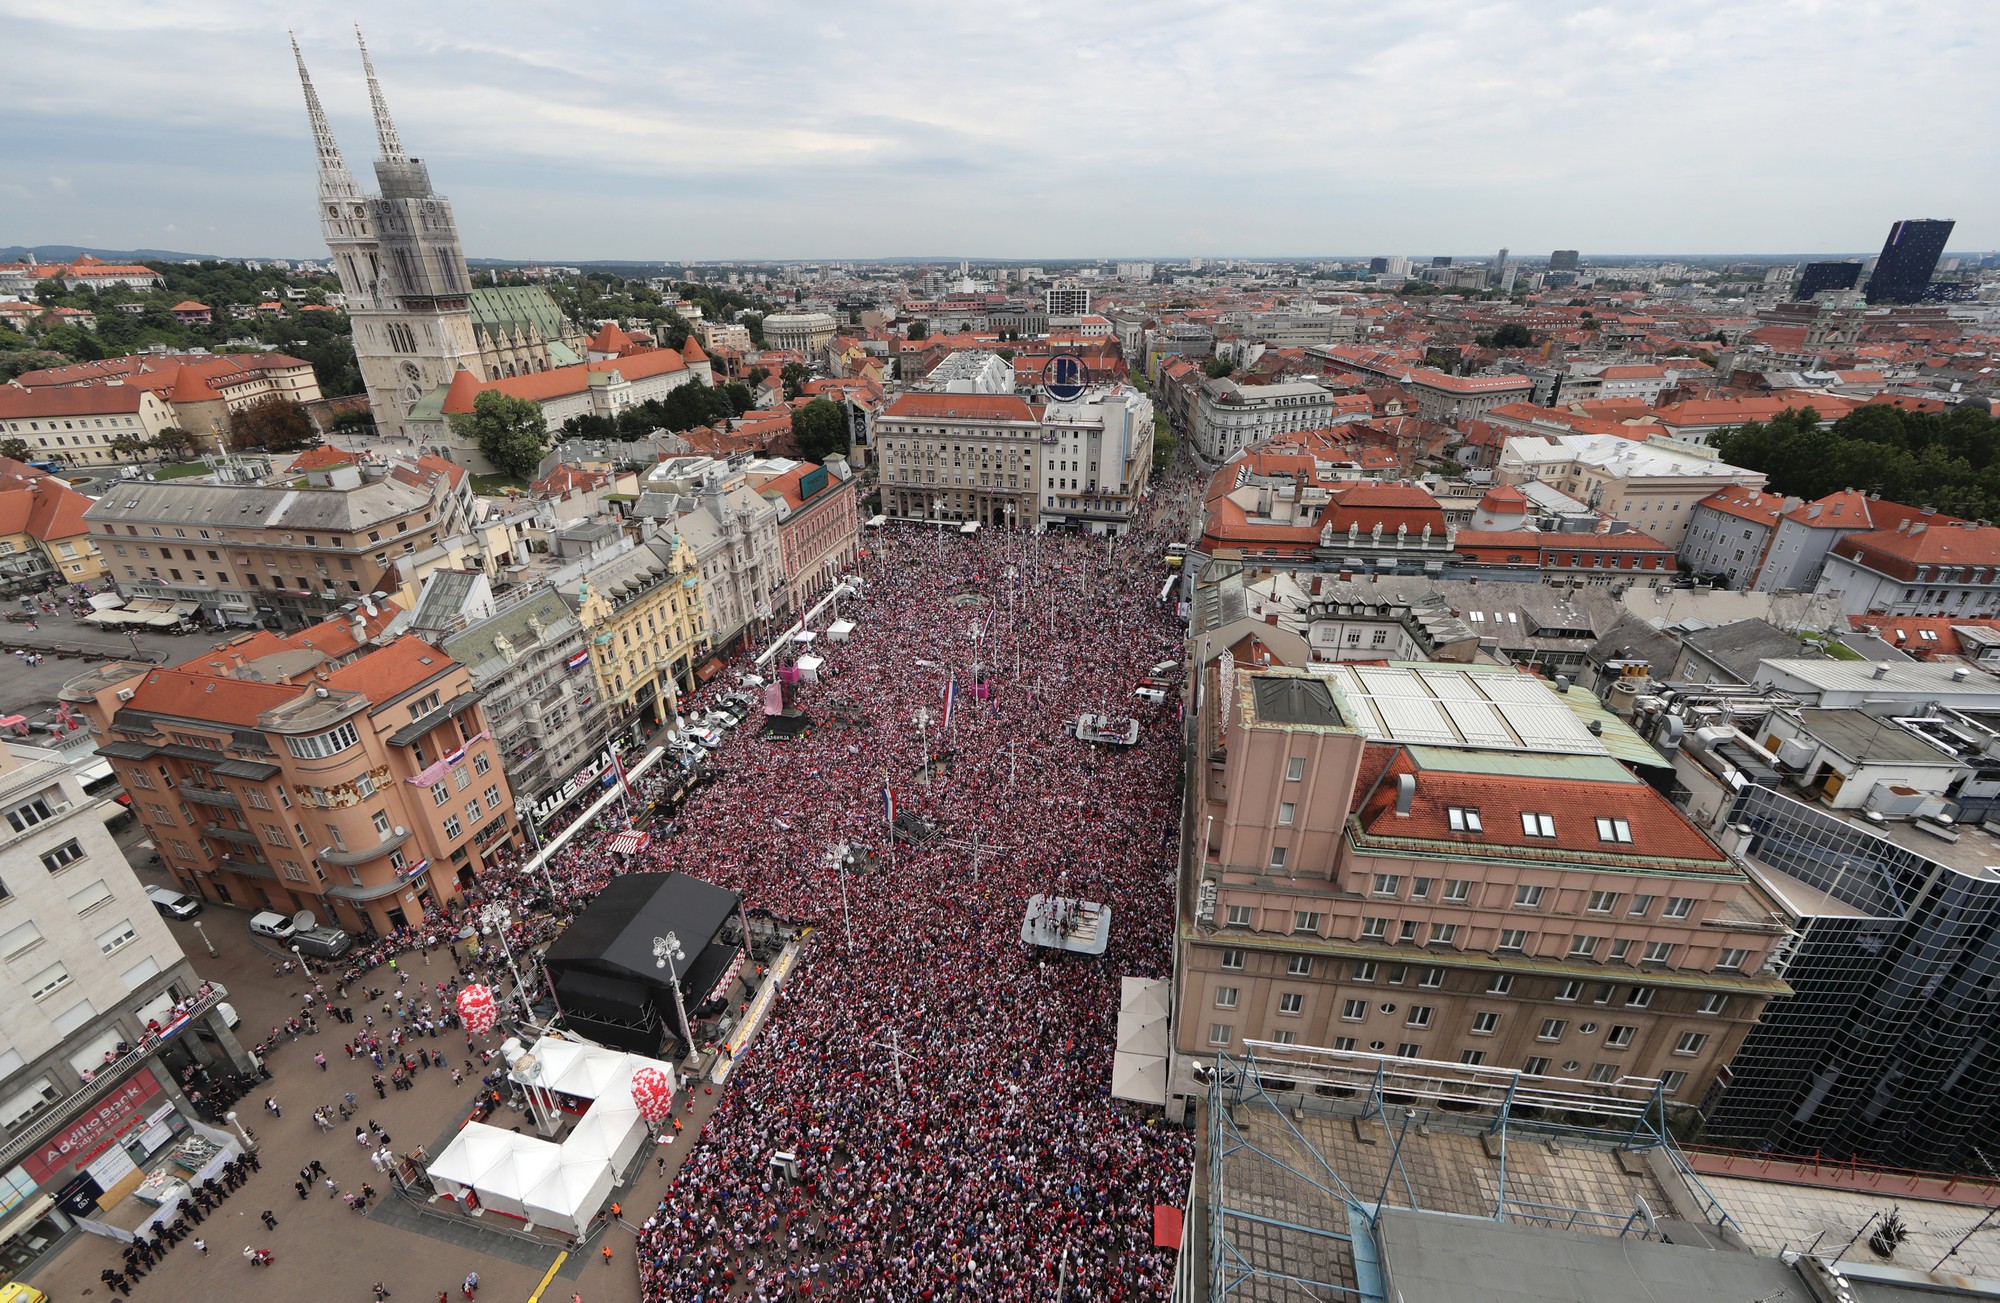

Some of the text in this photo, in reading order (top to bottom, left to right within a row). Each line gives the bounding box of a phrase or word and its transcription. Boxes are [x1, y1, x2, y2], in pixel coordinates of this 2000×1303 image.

[893, 449, 939, 459] GRADSKA
[47, 1117, 101, 1162] Addiko
[99, 1086, 139, 1120] Bank
[114, 1113, 144, 1139] Bank
